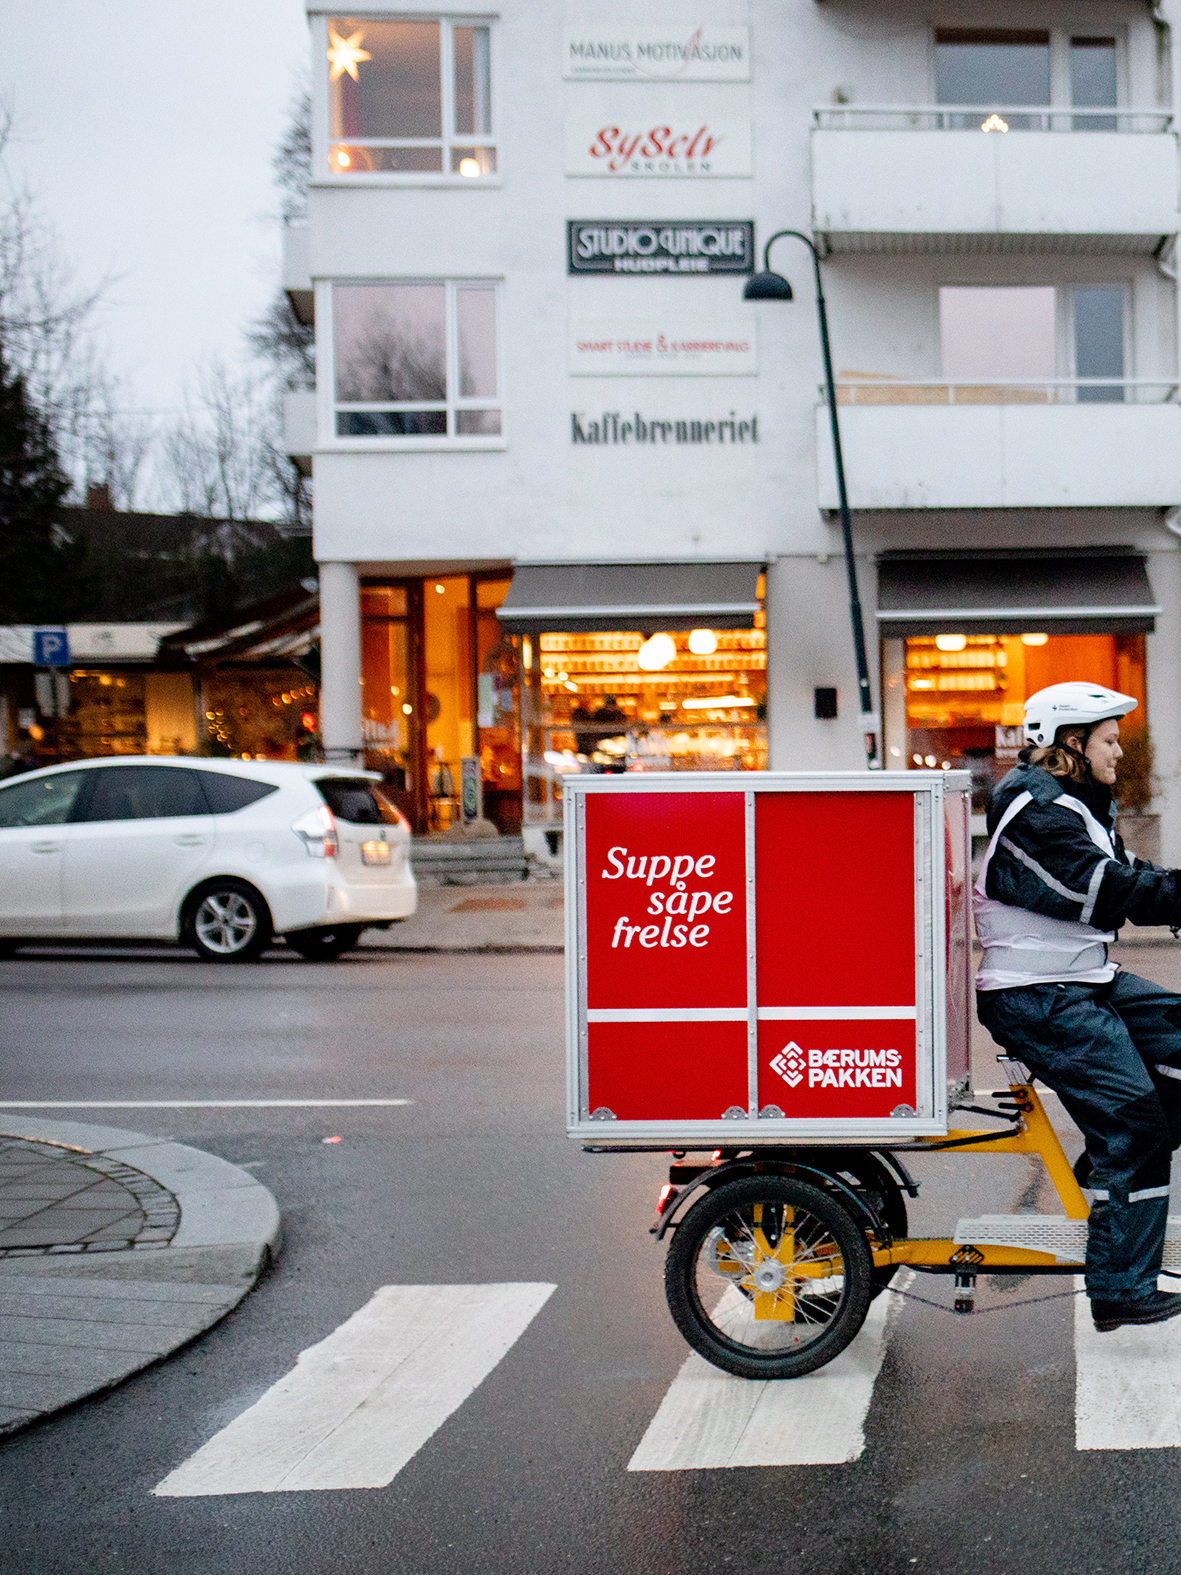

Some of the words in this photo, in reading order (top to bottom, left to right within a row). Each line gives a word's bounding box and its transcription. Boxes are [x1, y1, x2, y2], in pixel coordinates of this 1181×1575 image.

[569, 43, 631, 60] MANUS
[577, 228, 658, 258] STUDIO
[659, 229, 743, 255] UNIQUE
[571, 410, 759, 444] Kaffebrenneriet
[42, 634, 63, 661] P
[601, 846, 716, 886] Suppe
[647, 881, 733, 922] såpe
[611, 916, 710, 948] frelse
[808, 1068, 902, 1088] PAKKEN
